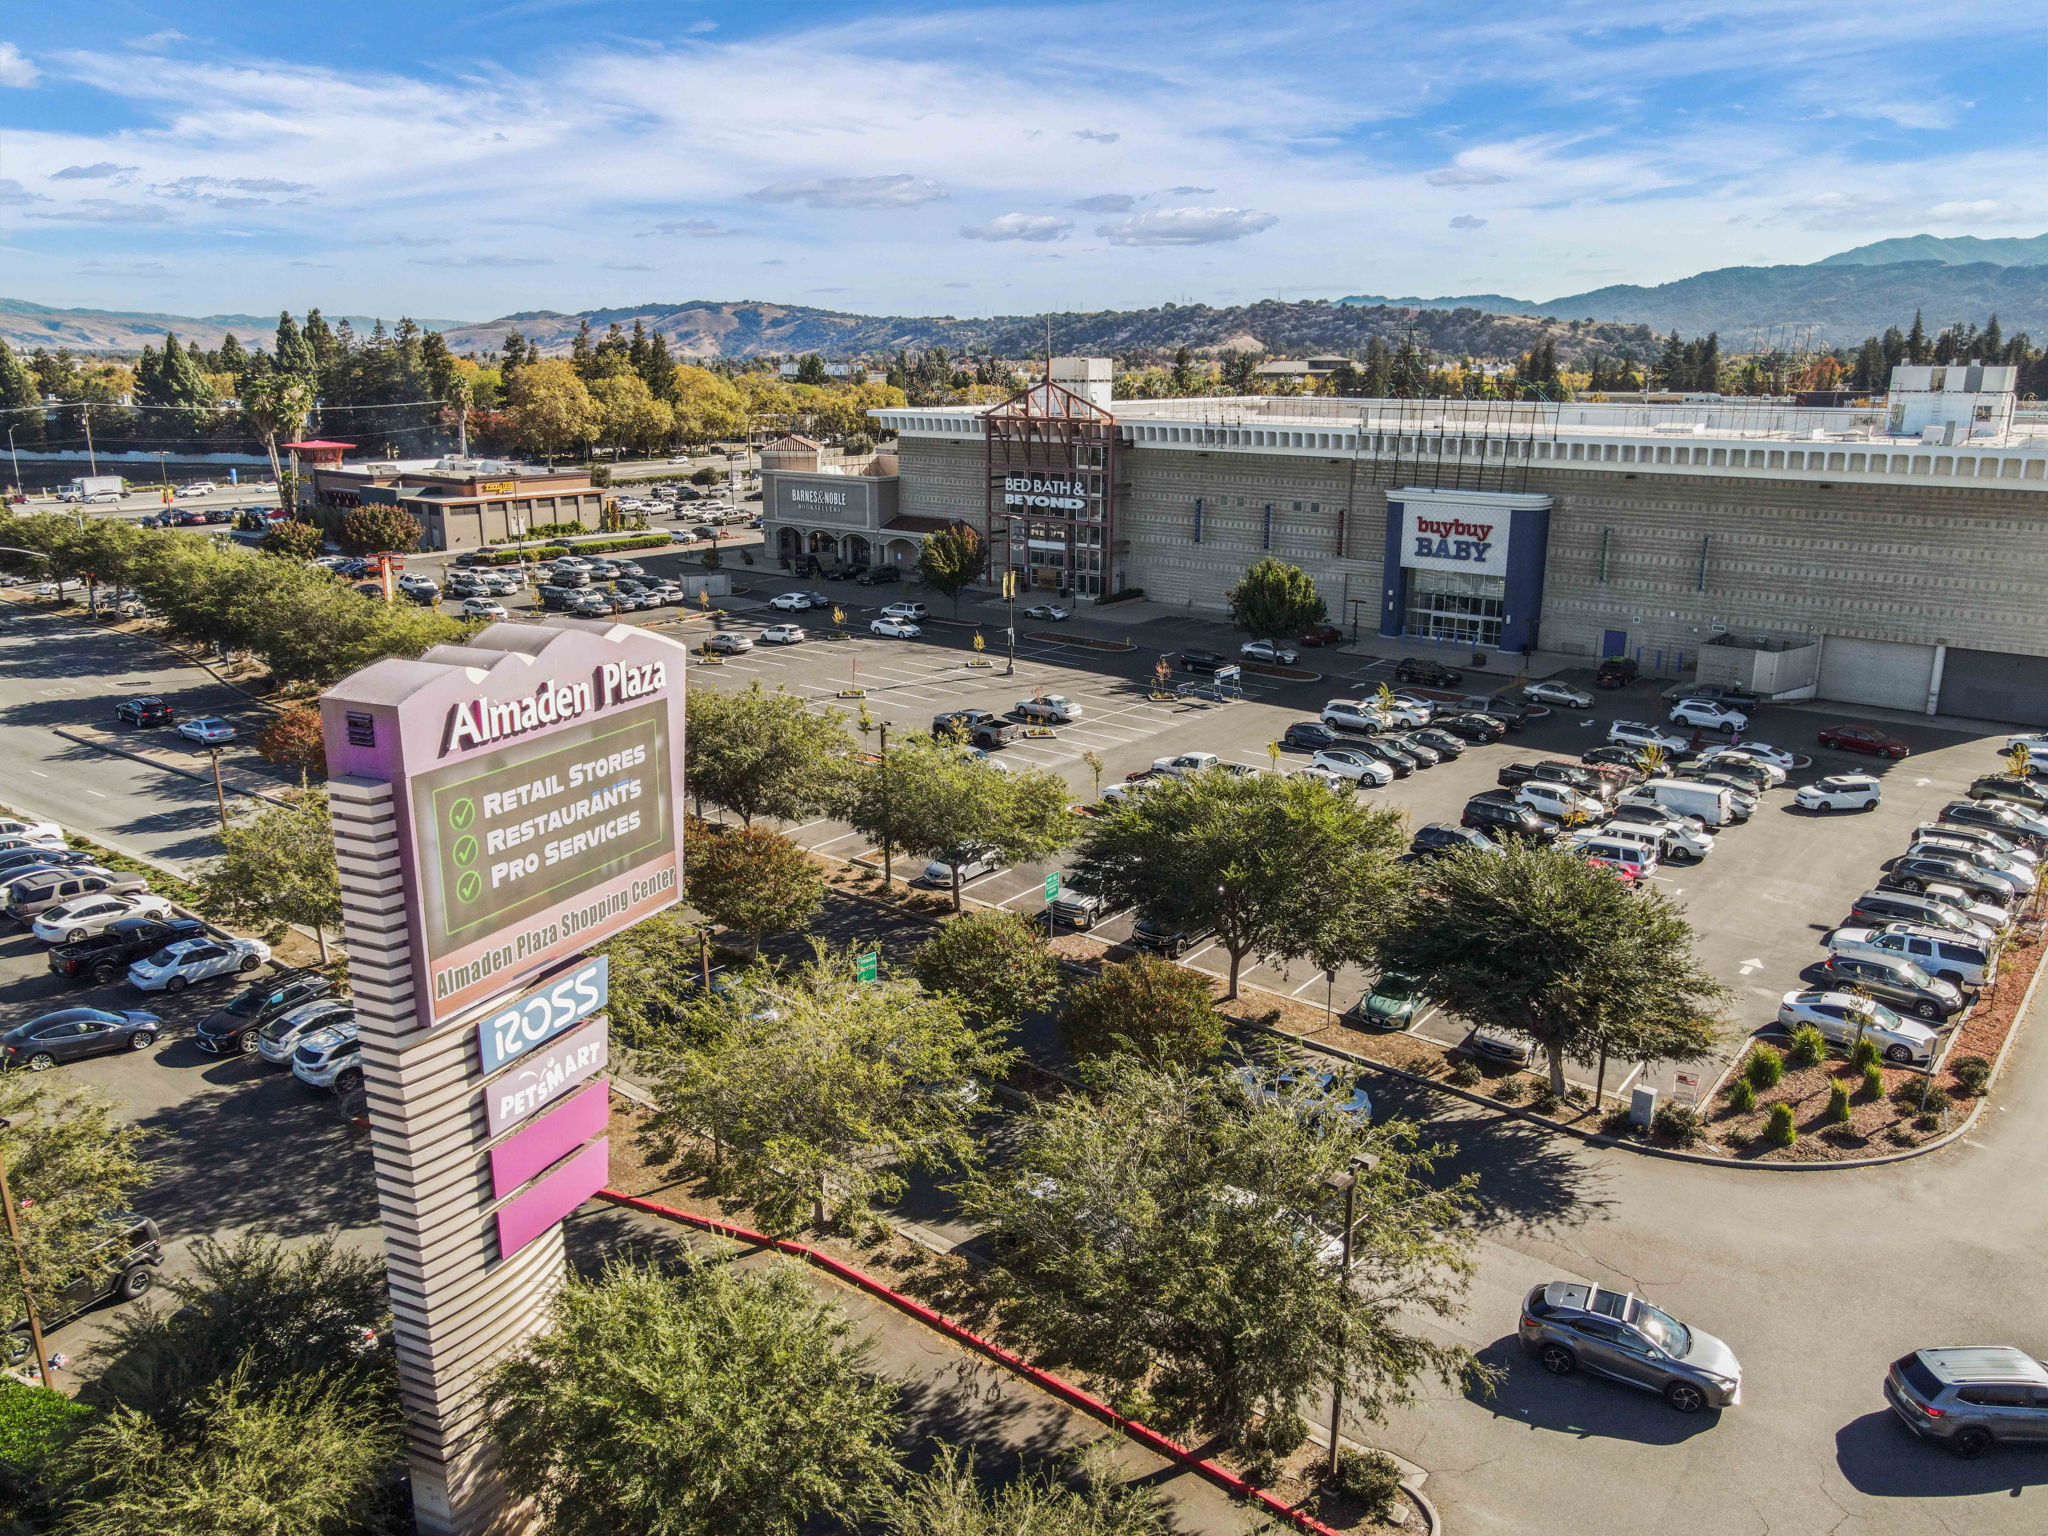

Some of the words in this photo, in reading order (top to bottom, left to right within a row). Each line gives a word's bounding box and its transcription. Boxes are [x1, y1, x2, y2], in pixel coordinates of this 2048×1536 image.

[798, 503, 841, 513] BOOKSELLERS
[1004, 493, 1086, 510] BEYOND
[1005, 478, 1031, 492] BED
[1033, 480, 1071, 495] BATH
[1073, 481, 1087, 497] &
[1414, 537, 1492, 562] BABY
[1417, 516, 1493, 542] buybuy
[447, 678, 592, 752] Almaden
[600, 659, 668, 705] Plaza
[482, 774, 565, 820] RETAIL
[568, 743, 647, 789] STORES
[486, 778, 643, 856] RESTAURANTS
[490, 852, 540, 889] PRO
[543, 810, 642, 867] SERVICES
[436, 943, 513, 1000] Almaden
[516, 925, 559, 962] Plaza
[560, 889, 629, 939] Shopping
[630, 866, 676, 904] Center
[494, 965, 600, 1061] ROSS
[499, 1041, 601, 1120] PETSMART
